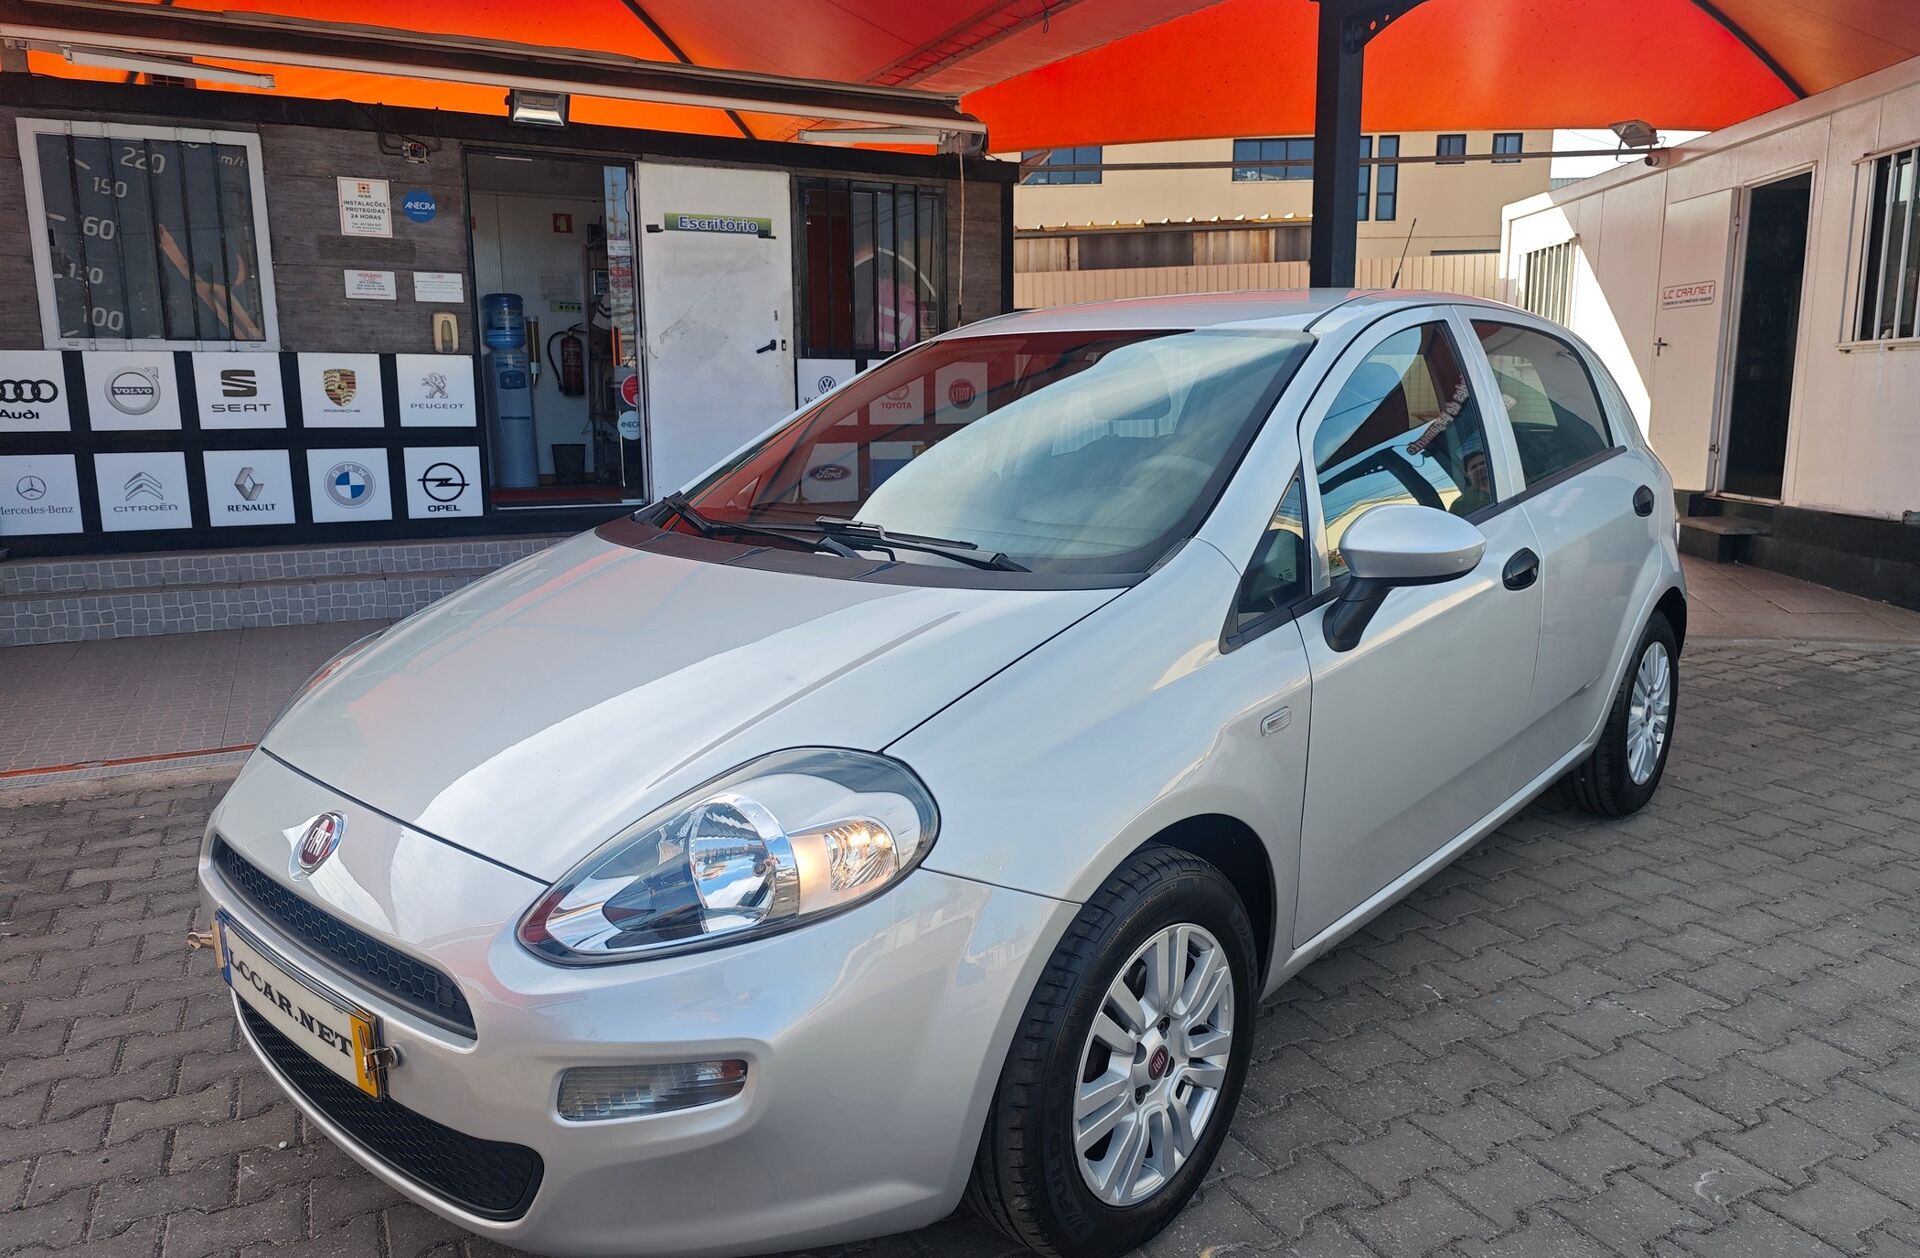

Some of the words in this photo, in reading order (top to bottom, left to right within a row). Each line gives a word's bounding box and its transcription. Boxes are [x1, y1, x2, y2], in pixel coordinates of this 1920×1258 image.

[120, 146, 166, 174] 220
[345, 206, 386, 214] PROTEGIDAS
[404, 201, 435, 211] ANECRA
[678, 215, 759, 233] Escritório
[82, 305, 124, 331] 100
[211, 403, 272, 413] SEAT
[881, 402, 912, 410] TOYOTA
[0, 409, 39, 420] Audi
[816, 467, 843, 480] Ford
[227, 503, 276, 512] RENAULT
[427, 504, 461, 512] OPEL
[304, 826, 331, 857] FIAT
[228, 947, 354, 1058] LCCAR.NET
